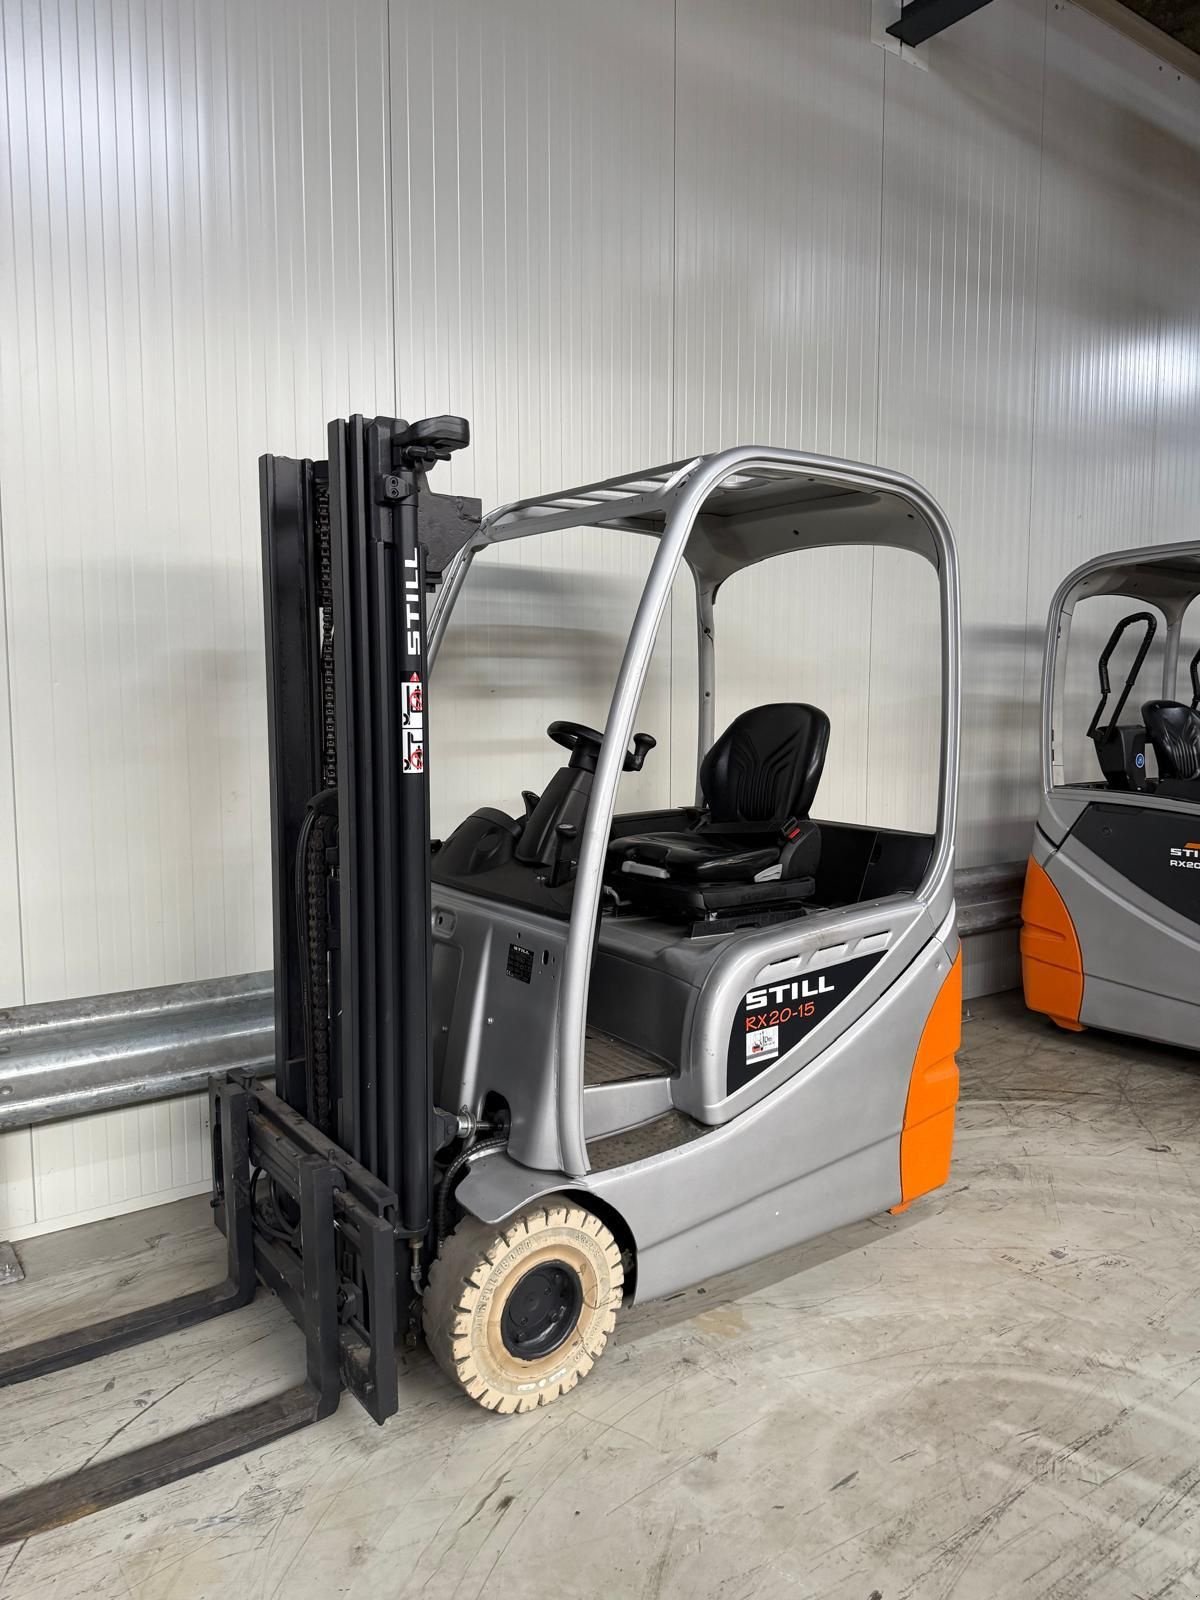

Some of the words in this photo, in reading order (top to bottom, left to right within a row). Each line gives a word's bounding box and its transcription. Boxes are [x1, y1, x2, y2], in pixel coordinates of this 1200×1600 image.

[404, 547, 420, 655] STILL
[746, 976, 834, 1011] STILL
[745, 1001, 816, 1032] RX20-15
